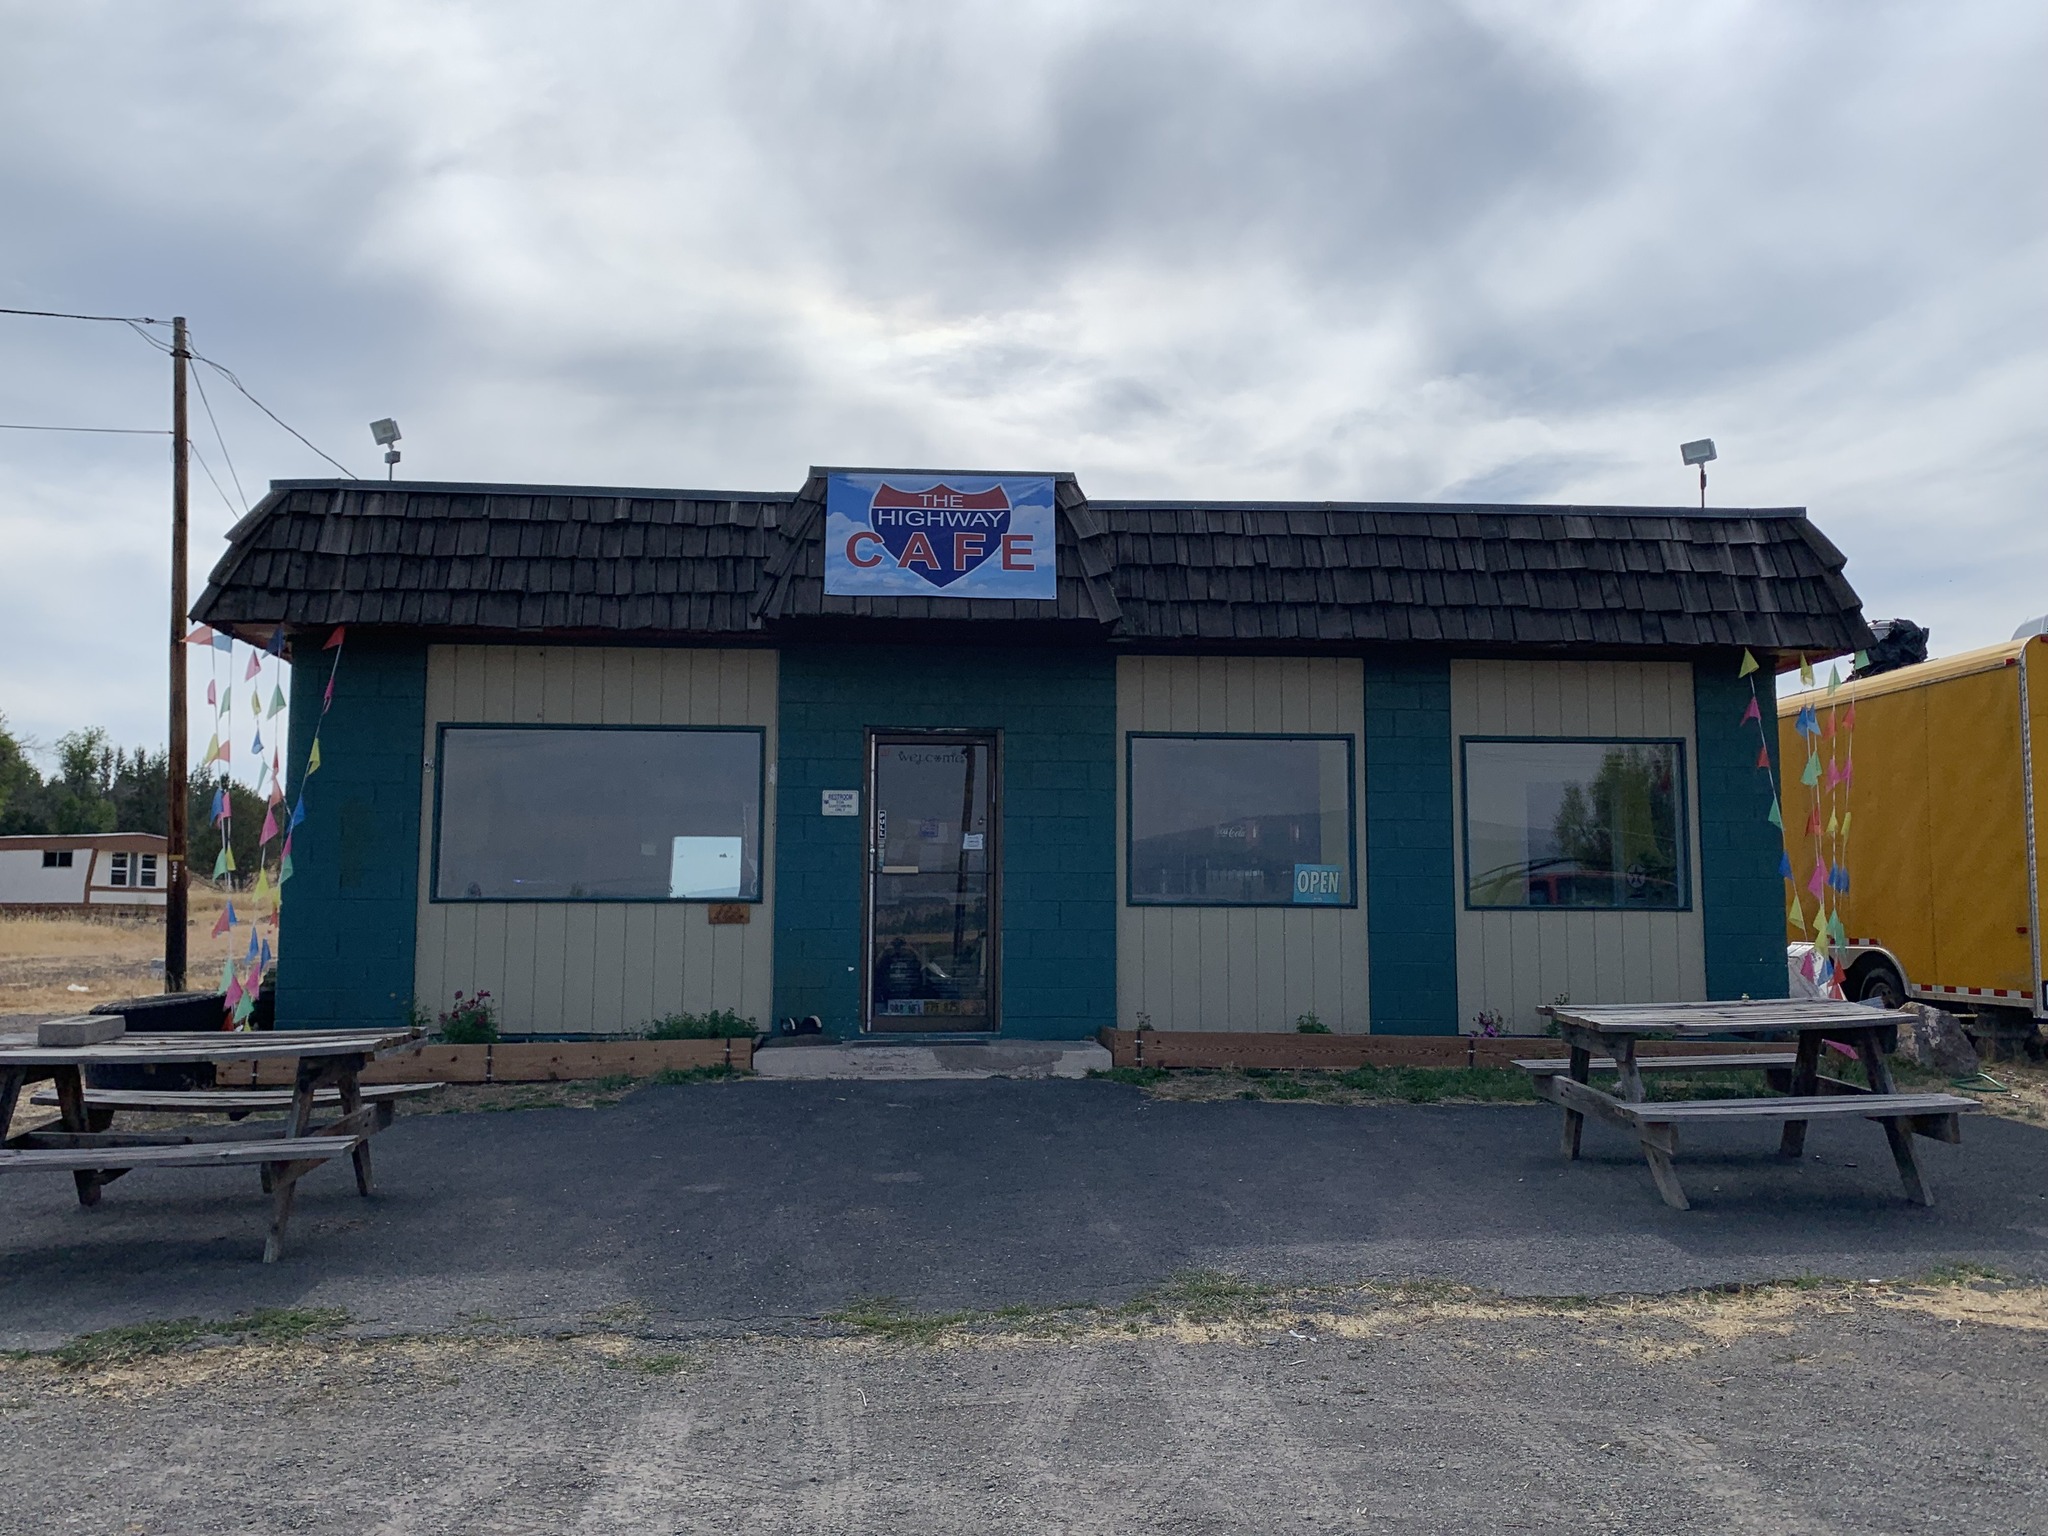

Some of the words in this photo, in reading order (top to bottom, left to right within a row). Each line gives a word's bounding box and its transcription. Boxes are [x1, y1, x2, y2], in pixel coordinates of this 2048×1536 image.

[918, 494, 964, 508] THE
[878, 510, 1005, 527] HIGHWAY
[845, 531, 1036, 572] CAFE
[1216, 823, 1246, 838] ocaCola
[1297, 870, 1339, 893] OPEN
